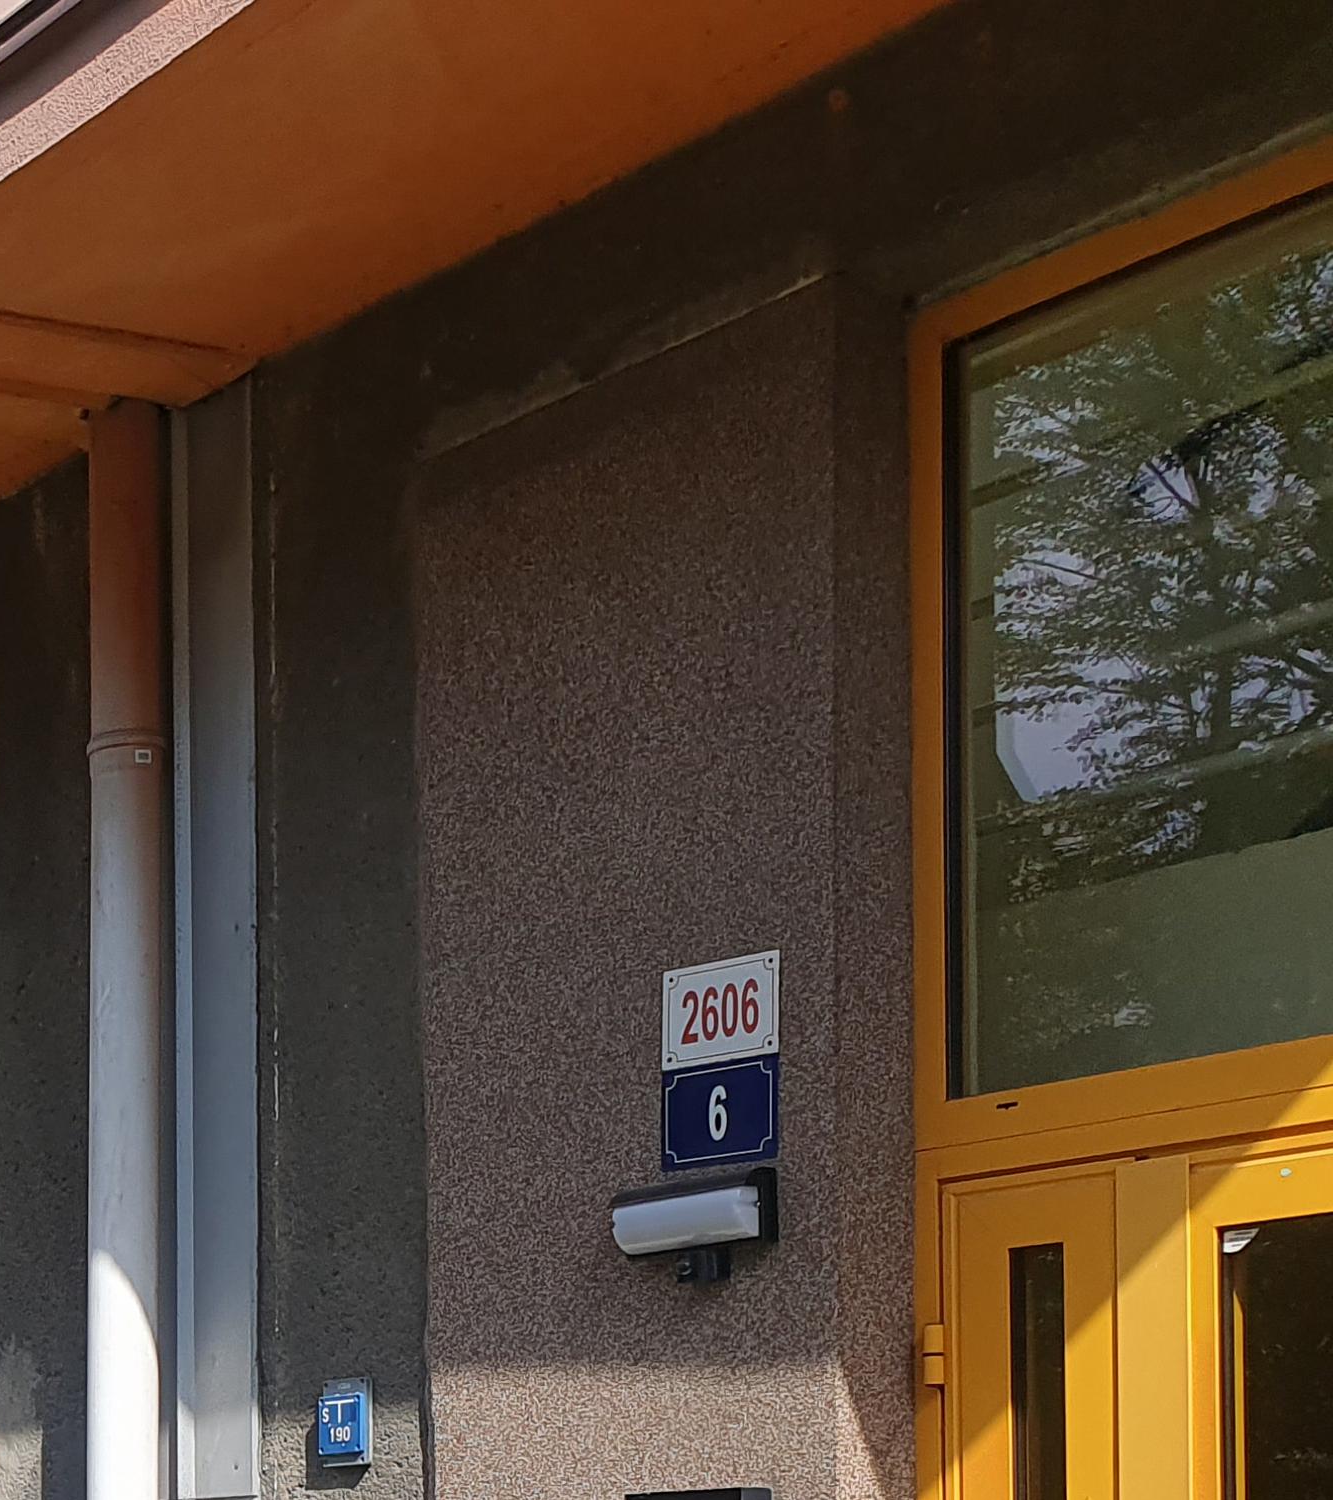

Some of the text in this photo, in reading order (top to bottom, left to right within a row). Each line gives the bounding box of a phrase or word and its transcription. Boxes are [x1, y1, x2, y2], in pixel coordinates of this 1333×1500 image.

[681, 978, 759, 1044] 2606
[708, 1085, 728, 1141] 6
[330, 1426, 350, 1443] 190
